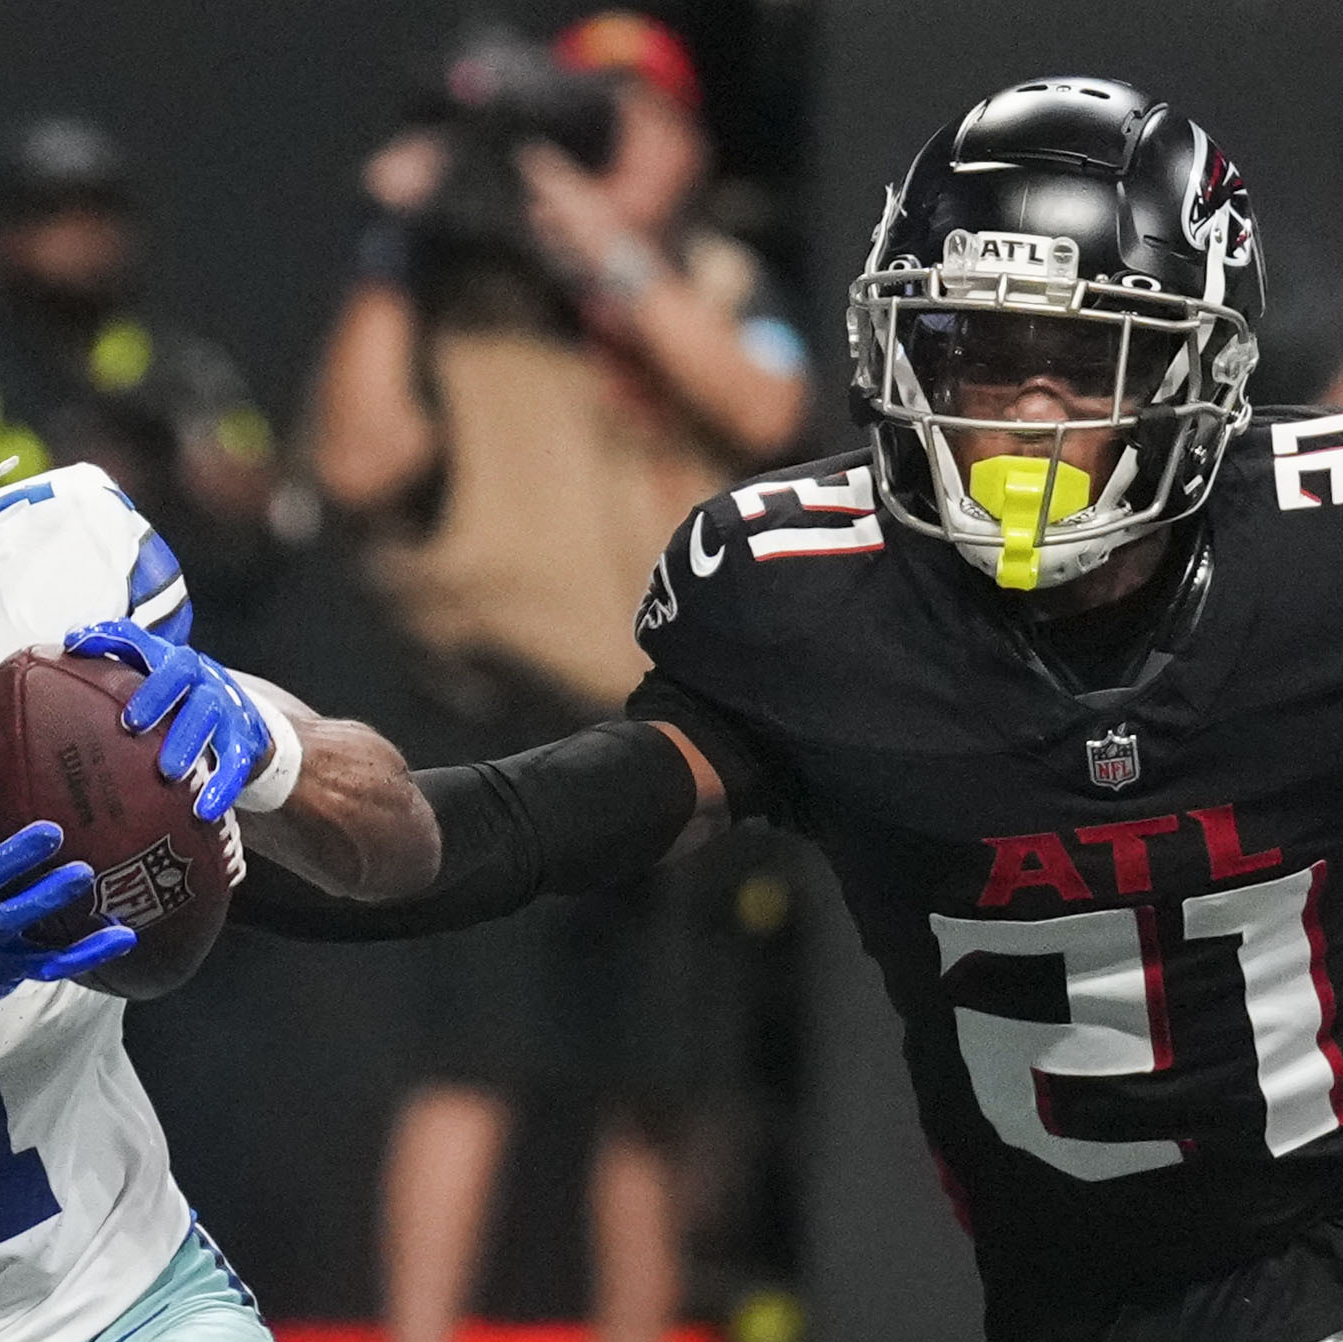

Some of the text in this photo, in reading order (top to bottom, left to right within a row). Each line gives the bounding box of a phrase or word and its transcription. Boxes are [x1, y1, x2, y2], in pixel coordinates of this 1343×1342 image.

[980, 239, 1045, 265] ATL
[729, 466, 886, 562] 21
[1097, 761, 1133, 780] NFL
[976, 804, 1284, 907] ATL
